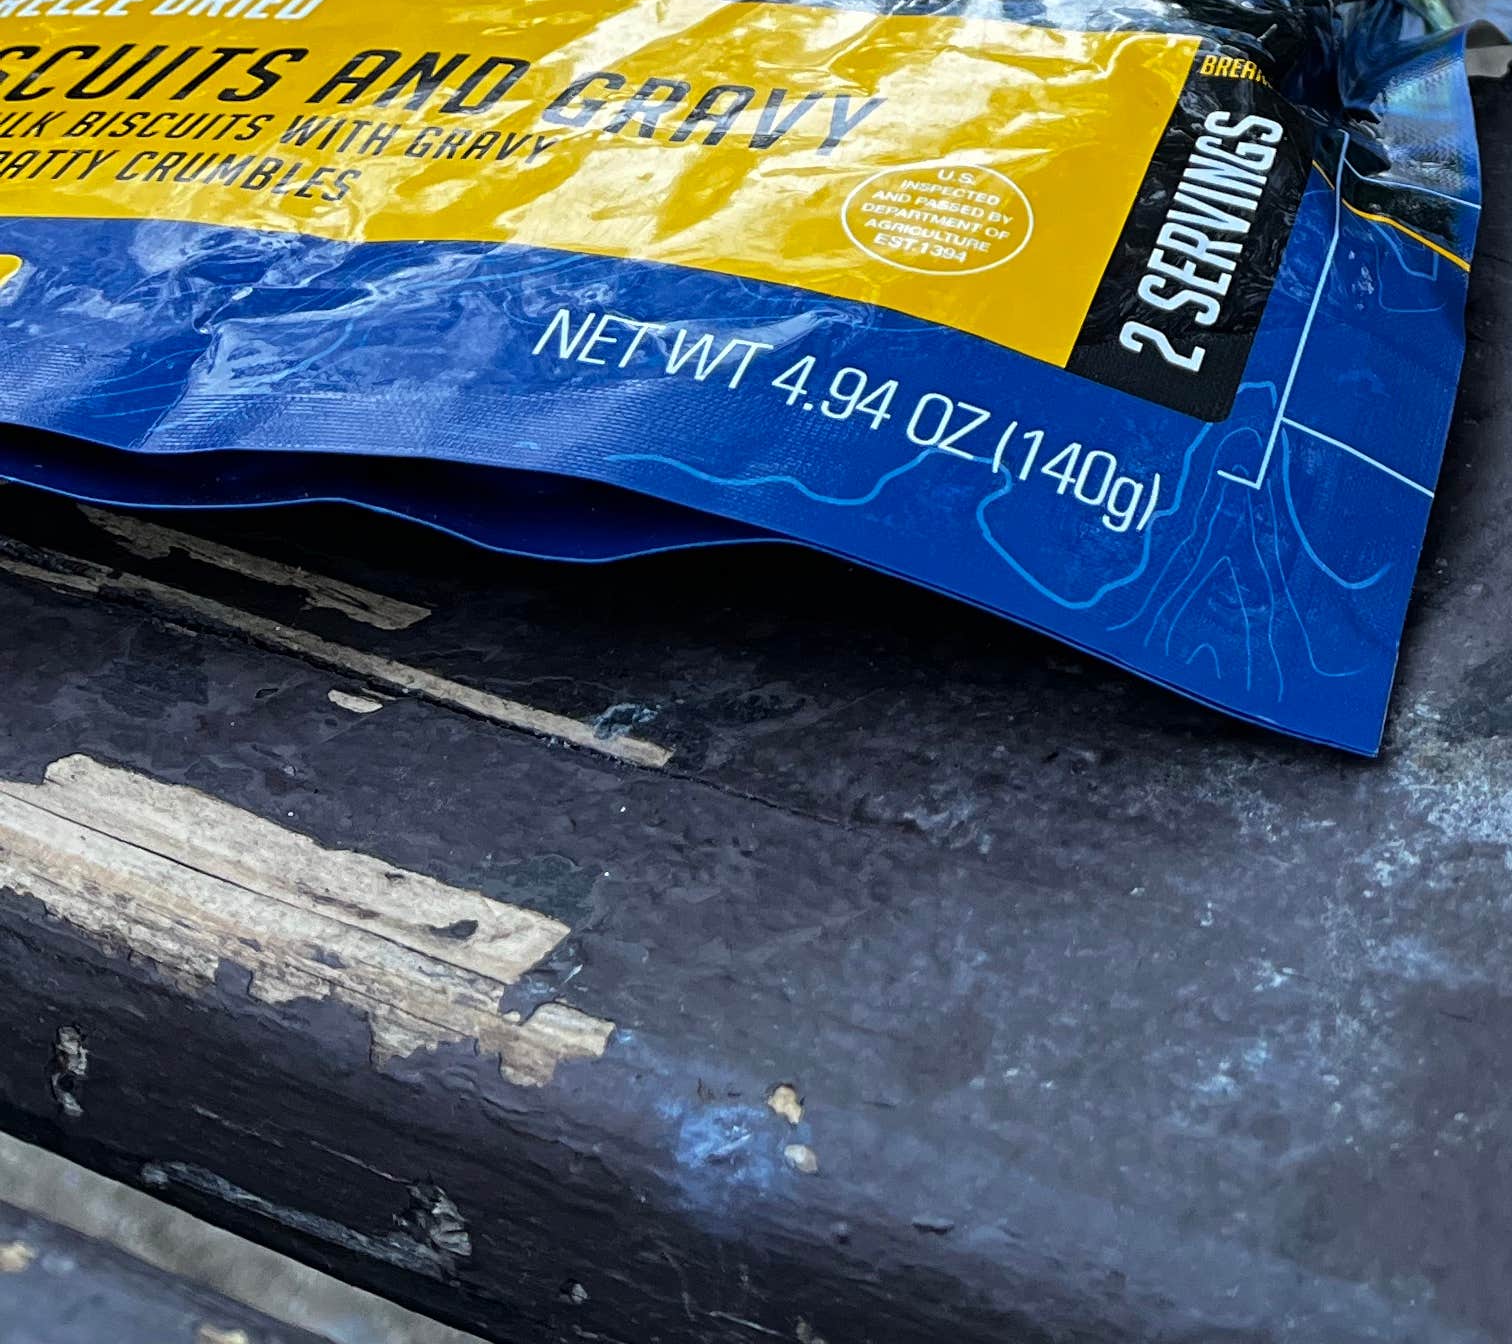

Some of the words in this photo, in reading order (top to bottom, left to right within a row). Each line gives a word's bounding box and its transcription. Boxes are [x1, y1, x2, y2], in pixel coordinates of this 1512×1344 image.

[304, 48, 532, 115] AND
[538, 71, 888, 156] GRAVY
[62, 111, 276, 141] BISCUITS
[280, 114, 404, 158] WITH
[411, 125, 558, 166] GRAVY
[114, 150, 363, 203] CRUMBLES
[901, 179, 1001, 206] INSPECTED
[860, 202, 984, 232] DEPARTMENT
[984, 227, 1010, 240] OF
[871, 190, 912, 204] AND
[914, 197, 985, 218] PASSED
[987, 210, 1014, 225] BY
[1137, 110, 1285, 326] SERVINGS
[864, 218, 993, 253] AGRICULTURE
[1119, 318, 1206, 373] 2
[531, 308, 664, 368] NET
[666, 326, 774, 390] WT
[771, 355, 899, 431] 4.94
[906, 392, 991, 461] OZ
[991, 420, 1162, 534] (140g)
